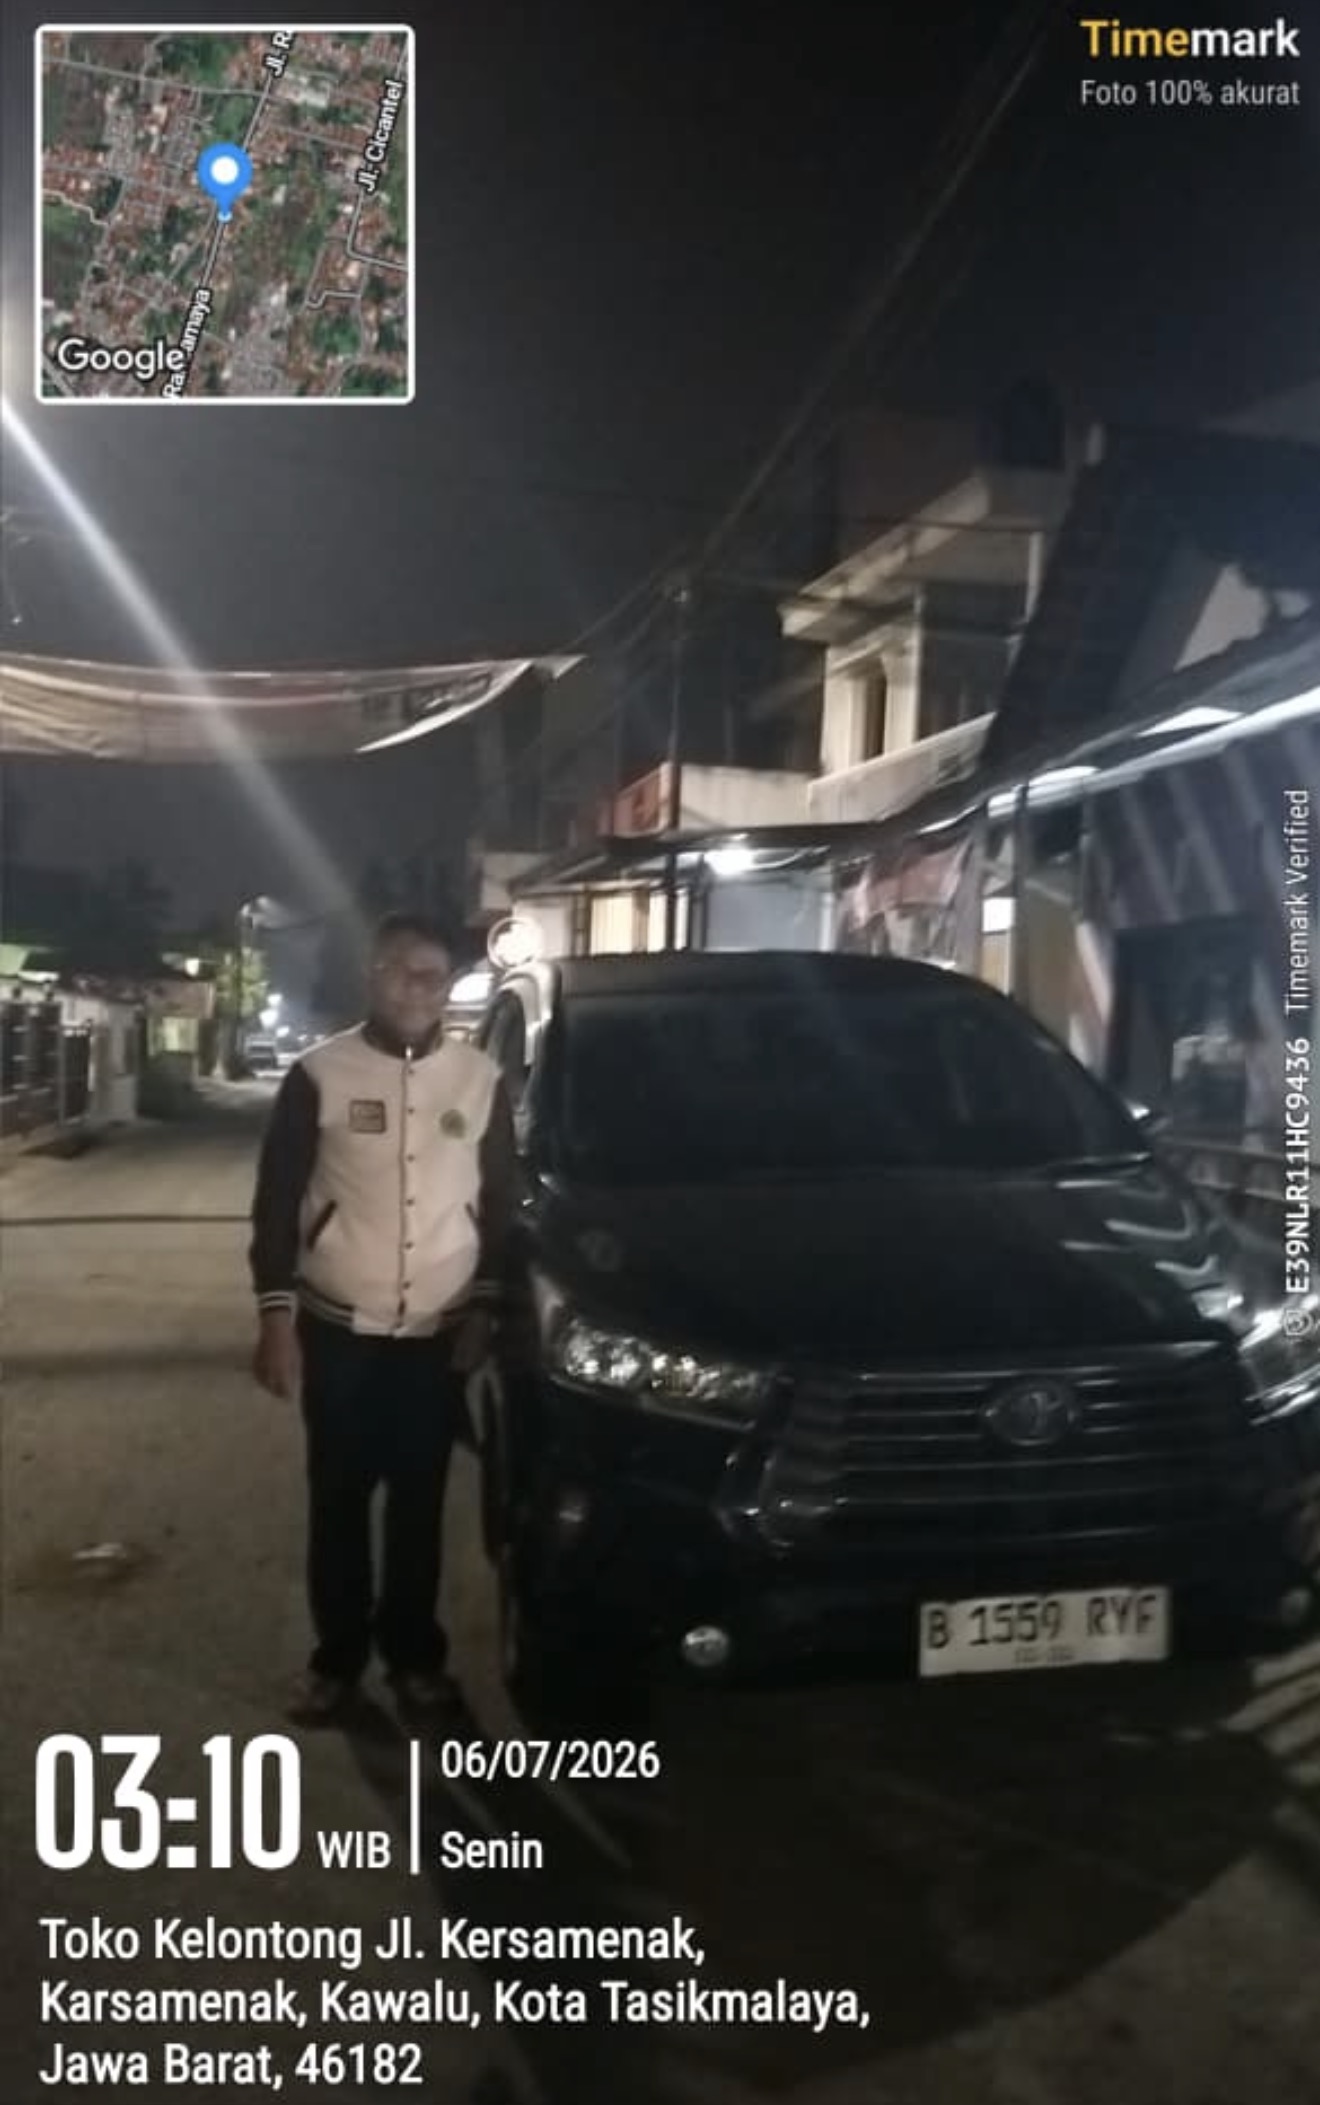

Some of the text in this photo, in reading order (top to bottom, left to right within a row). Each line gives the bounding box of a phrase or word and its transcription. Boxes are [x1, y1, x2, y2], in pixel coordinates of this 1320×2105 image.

[927, 1595, 1157, 1649] B 1559 RYF
